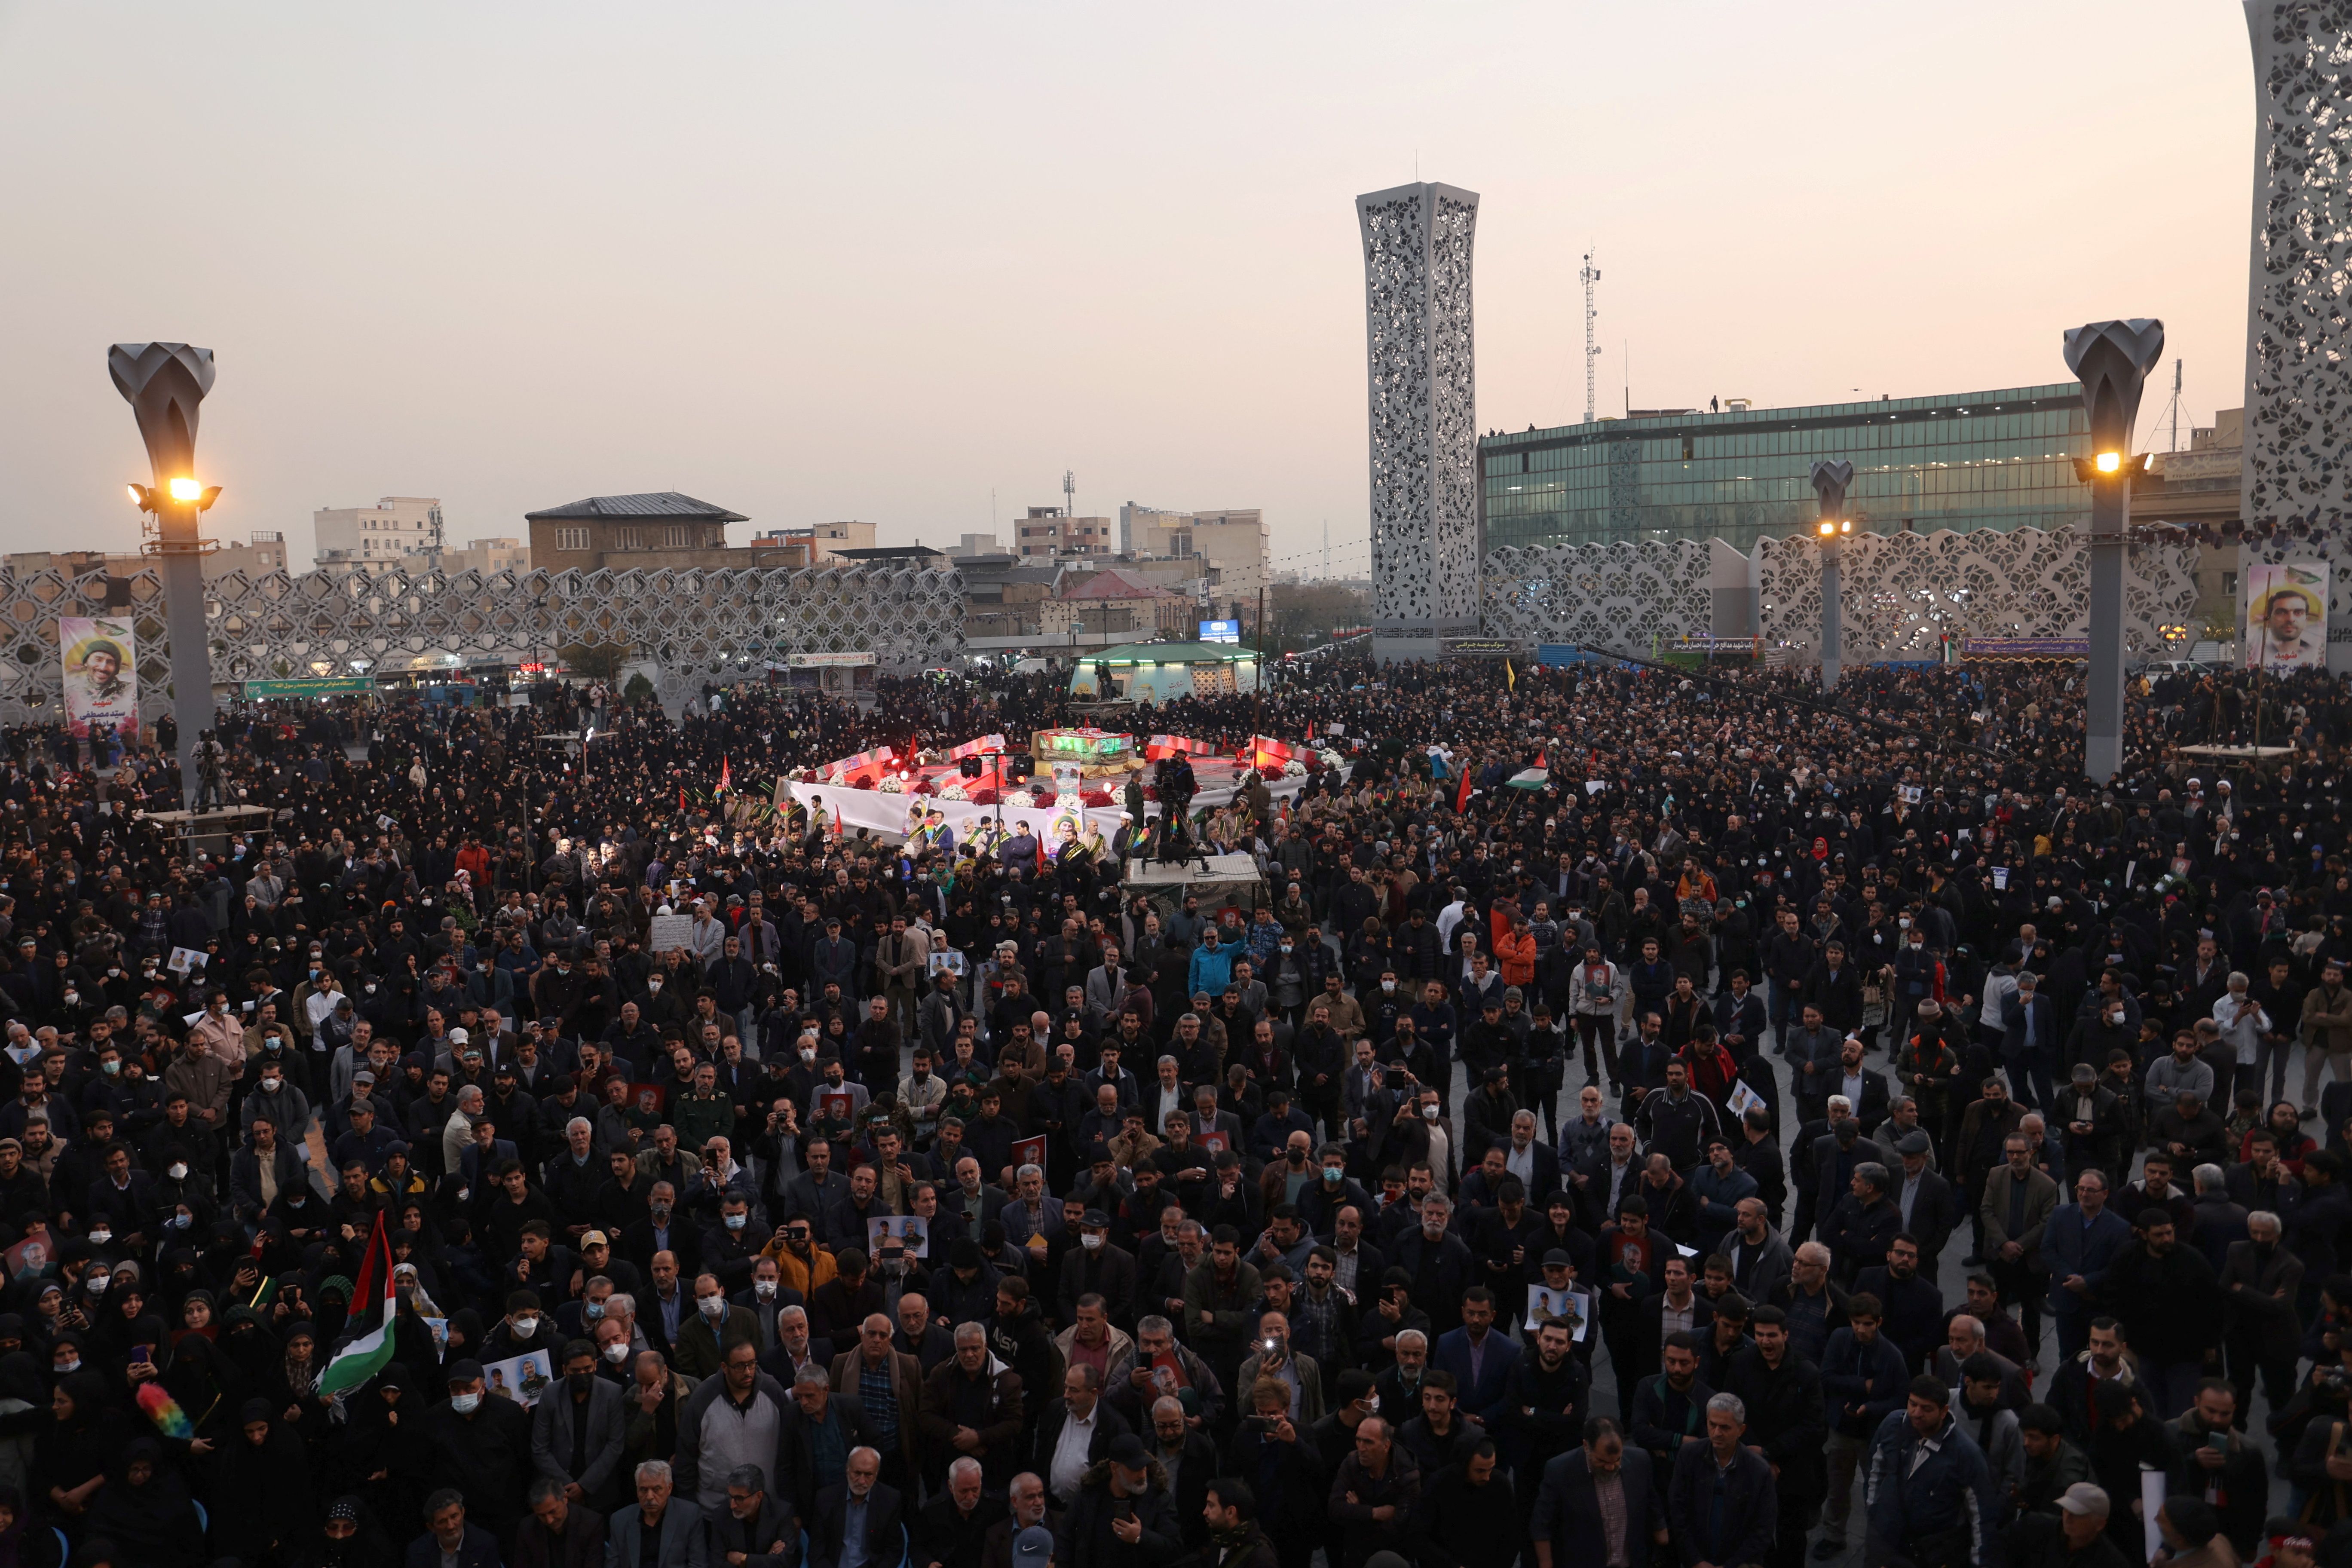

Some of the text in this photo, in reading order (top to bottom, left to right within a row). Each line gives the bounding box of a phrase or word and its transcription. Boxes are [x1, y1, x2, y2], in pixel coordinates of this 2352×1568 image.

[1688, 640, 1702, 649] احسان
[1720, 640, 1732, 650] مدافع
[1733, 640, 1744, 649] شهید
[1744, 641, 1754, 649] وکب
[2275, 650, 2297, 661] شهید
[2266, 662, 2314, 674] الس چگین
[92, 698, 112, 707] شهید
[80, 710, 109, 720] مصطفی
